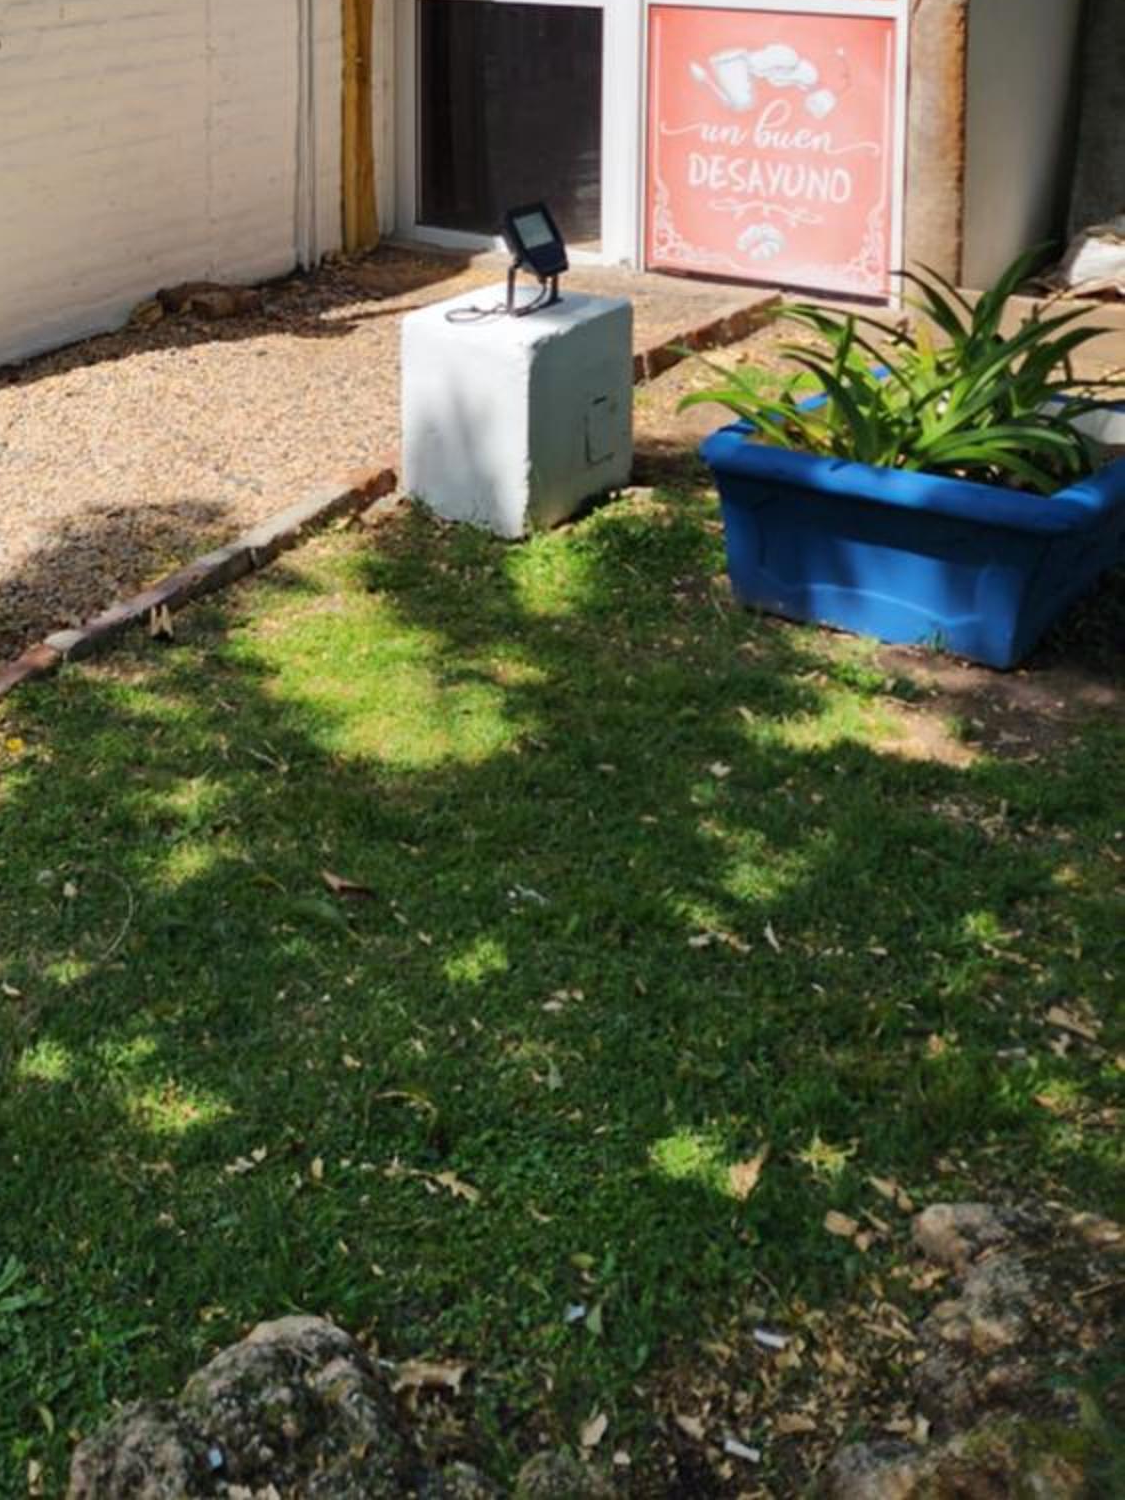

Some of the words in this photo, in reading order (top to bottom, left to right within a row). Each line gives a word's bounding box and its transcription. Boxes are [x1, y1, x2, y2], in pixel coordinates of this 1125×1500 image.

[698, 120, 746, 146] un
[753, 99, 834, 150] buen
[686, 152, 852, 203] DESAYUNO
